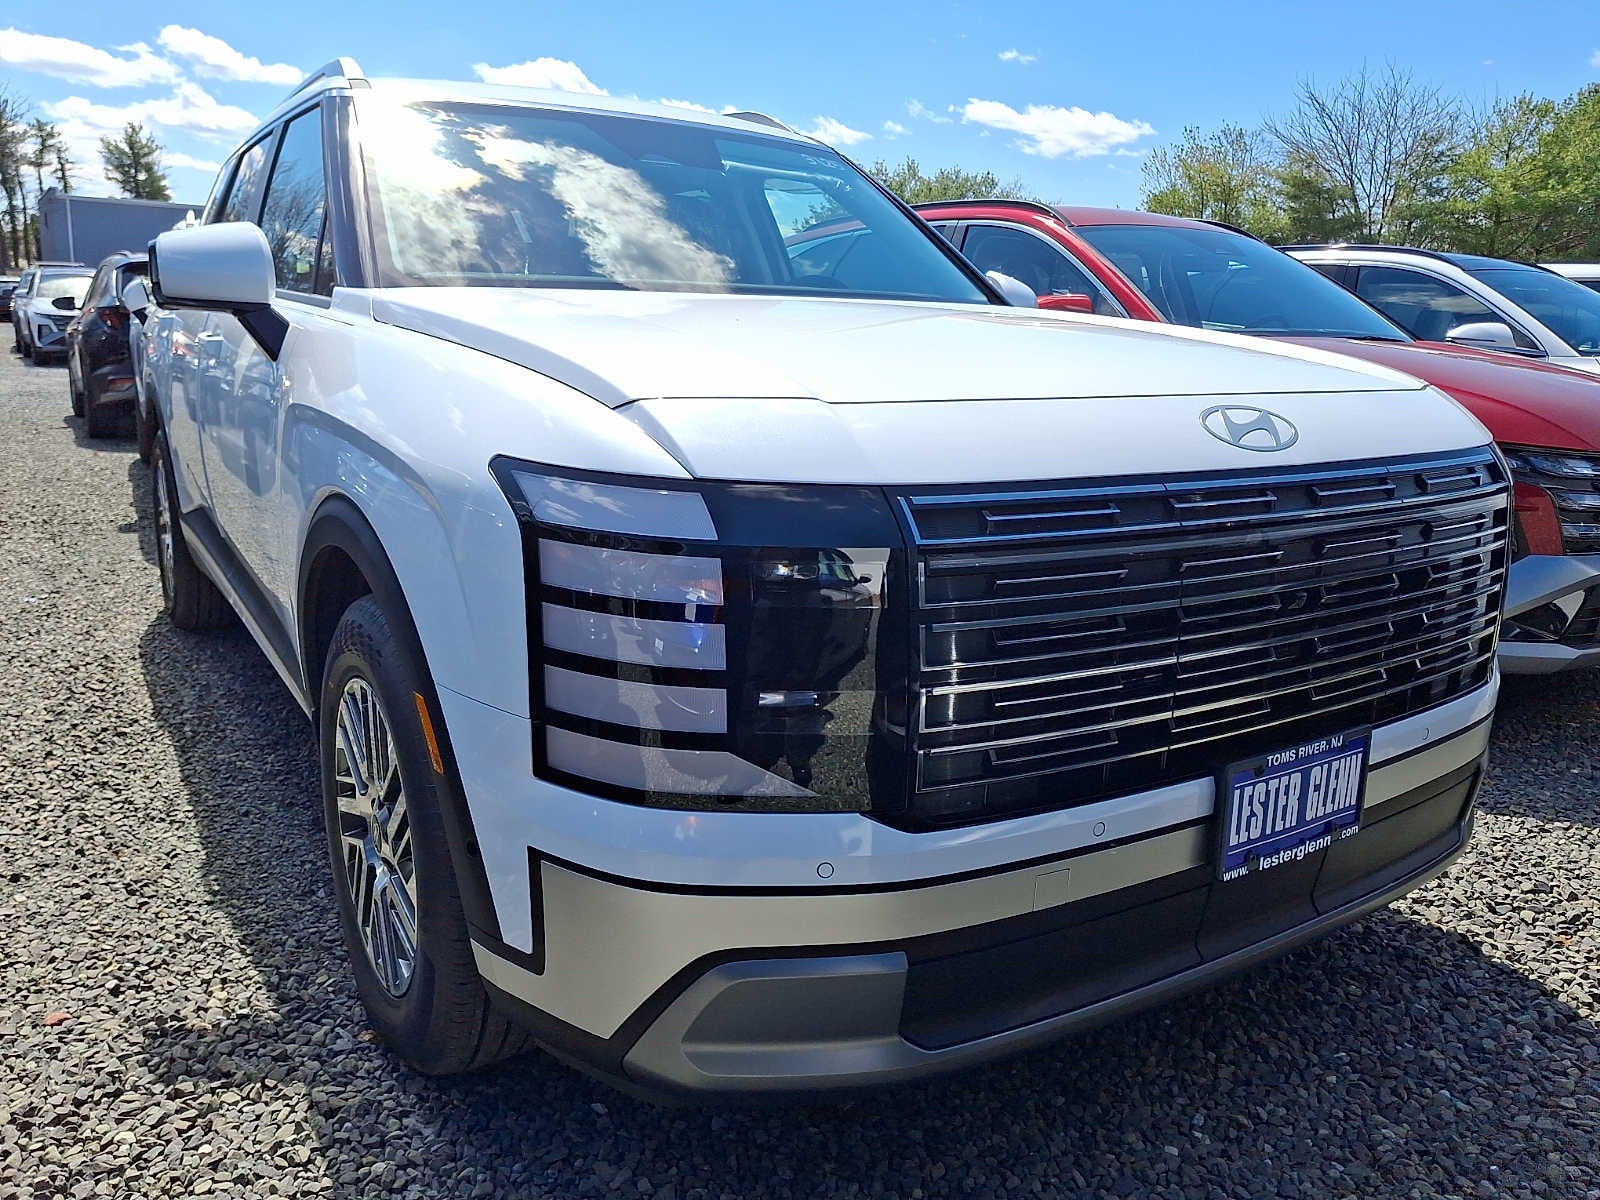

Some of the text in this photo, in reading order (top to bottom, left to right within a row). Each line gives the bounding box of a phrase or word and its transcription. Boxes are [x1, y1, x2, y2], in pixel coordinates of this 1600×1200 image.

[1267, 735, 1344, 768] TOMS RIVER, NJ
[1229, 752, 1363, 847] LESTER GLENN
